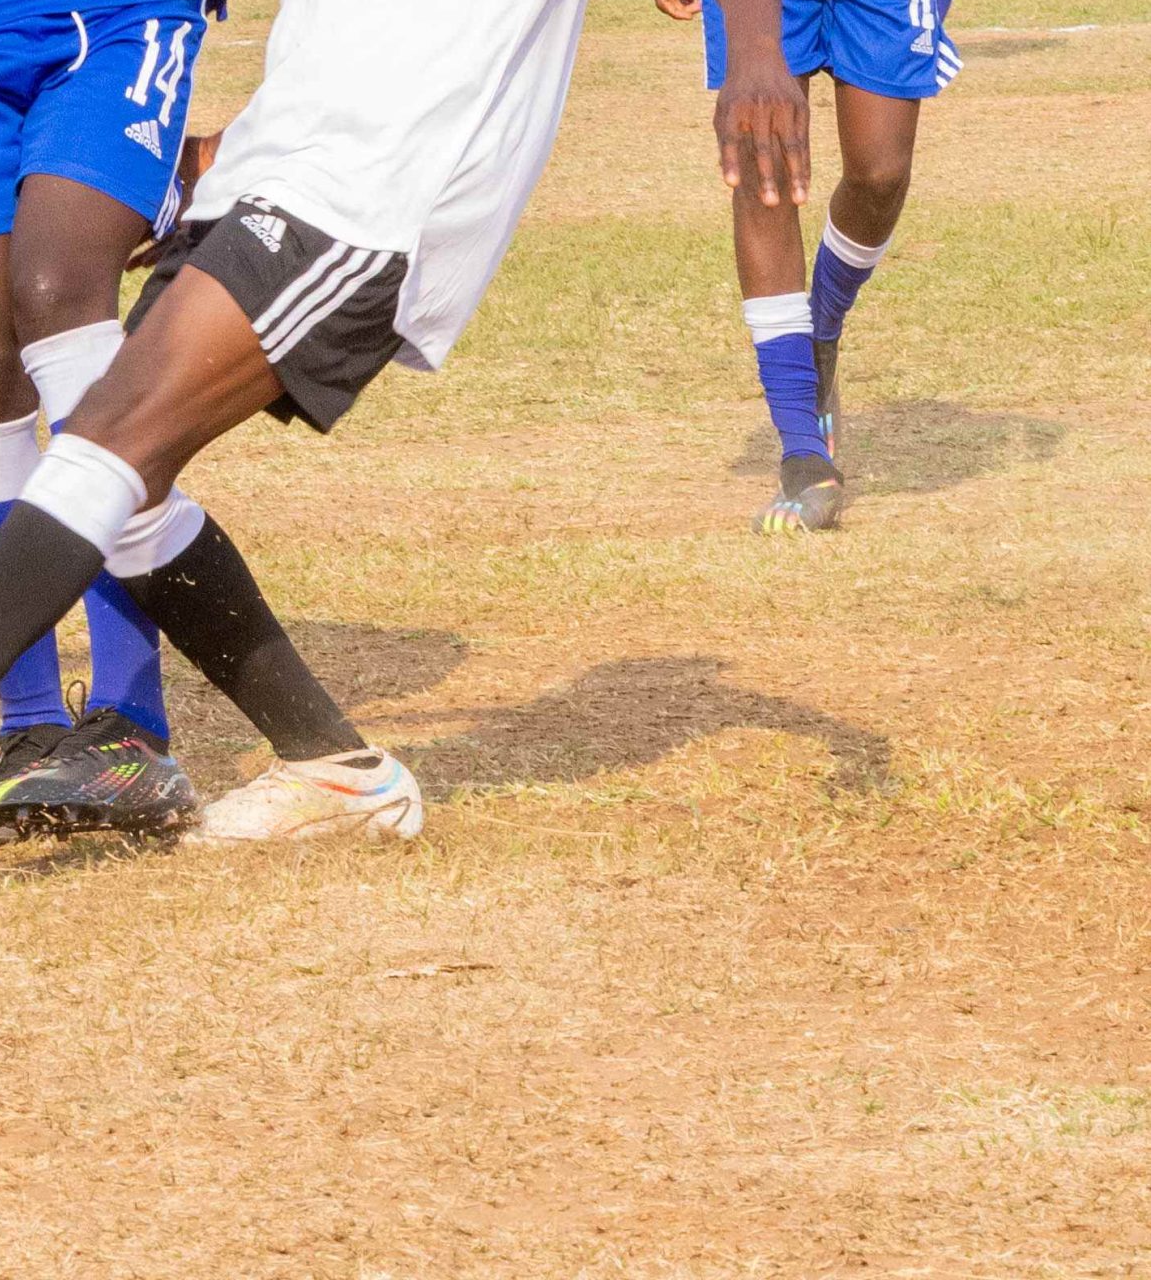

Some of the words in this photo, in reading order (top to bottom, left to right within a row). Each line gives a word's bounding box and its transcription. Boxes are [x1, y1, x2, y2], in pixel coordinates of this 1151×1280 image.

[125, 19, 192, 127] 14
[124, 127, 162, 160] adidas
[240, 215, 282, 253] adidas
